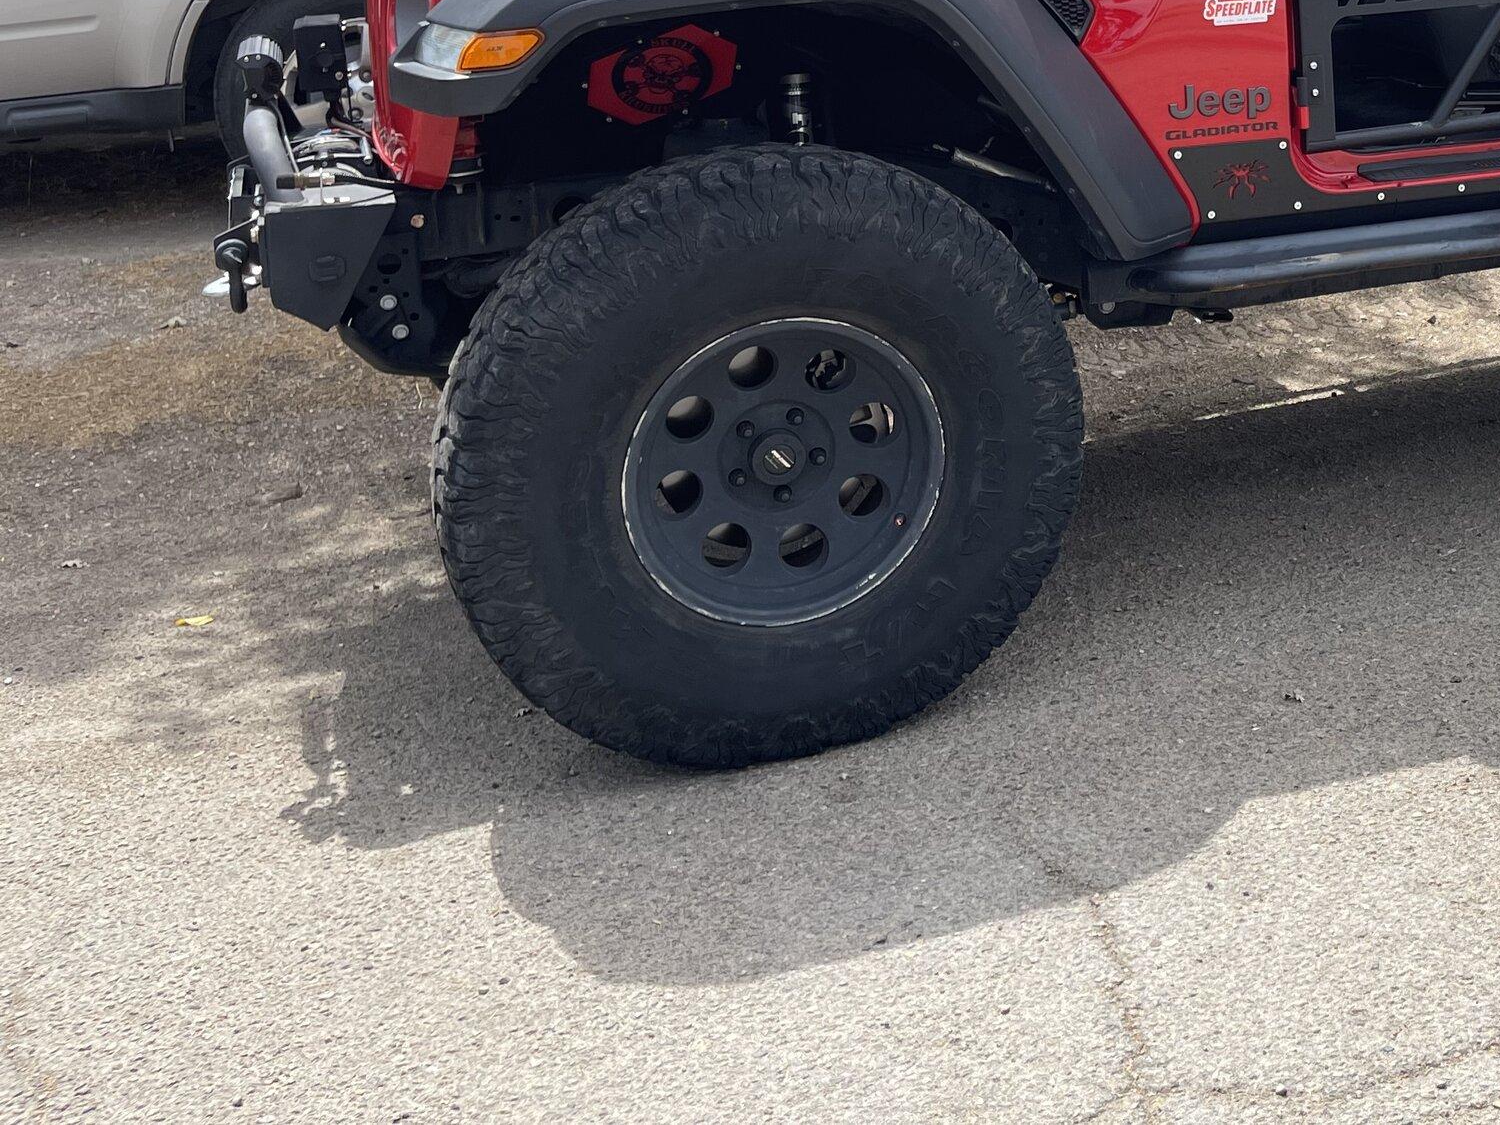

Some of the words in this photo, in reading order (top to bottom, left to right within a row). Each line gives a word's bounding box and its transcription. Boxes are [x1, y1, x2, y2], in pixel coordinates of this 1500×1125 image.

[1205, 0, 1274, 18] SPEEDFLATE
[1168, 84, 1272, 120] Jeep
[1165, 121, 1279, 141] GLADIATOR
